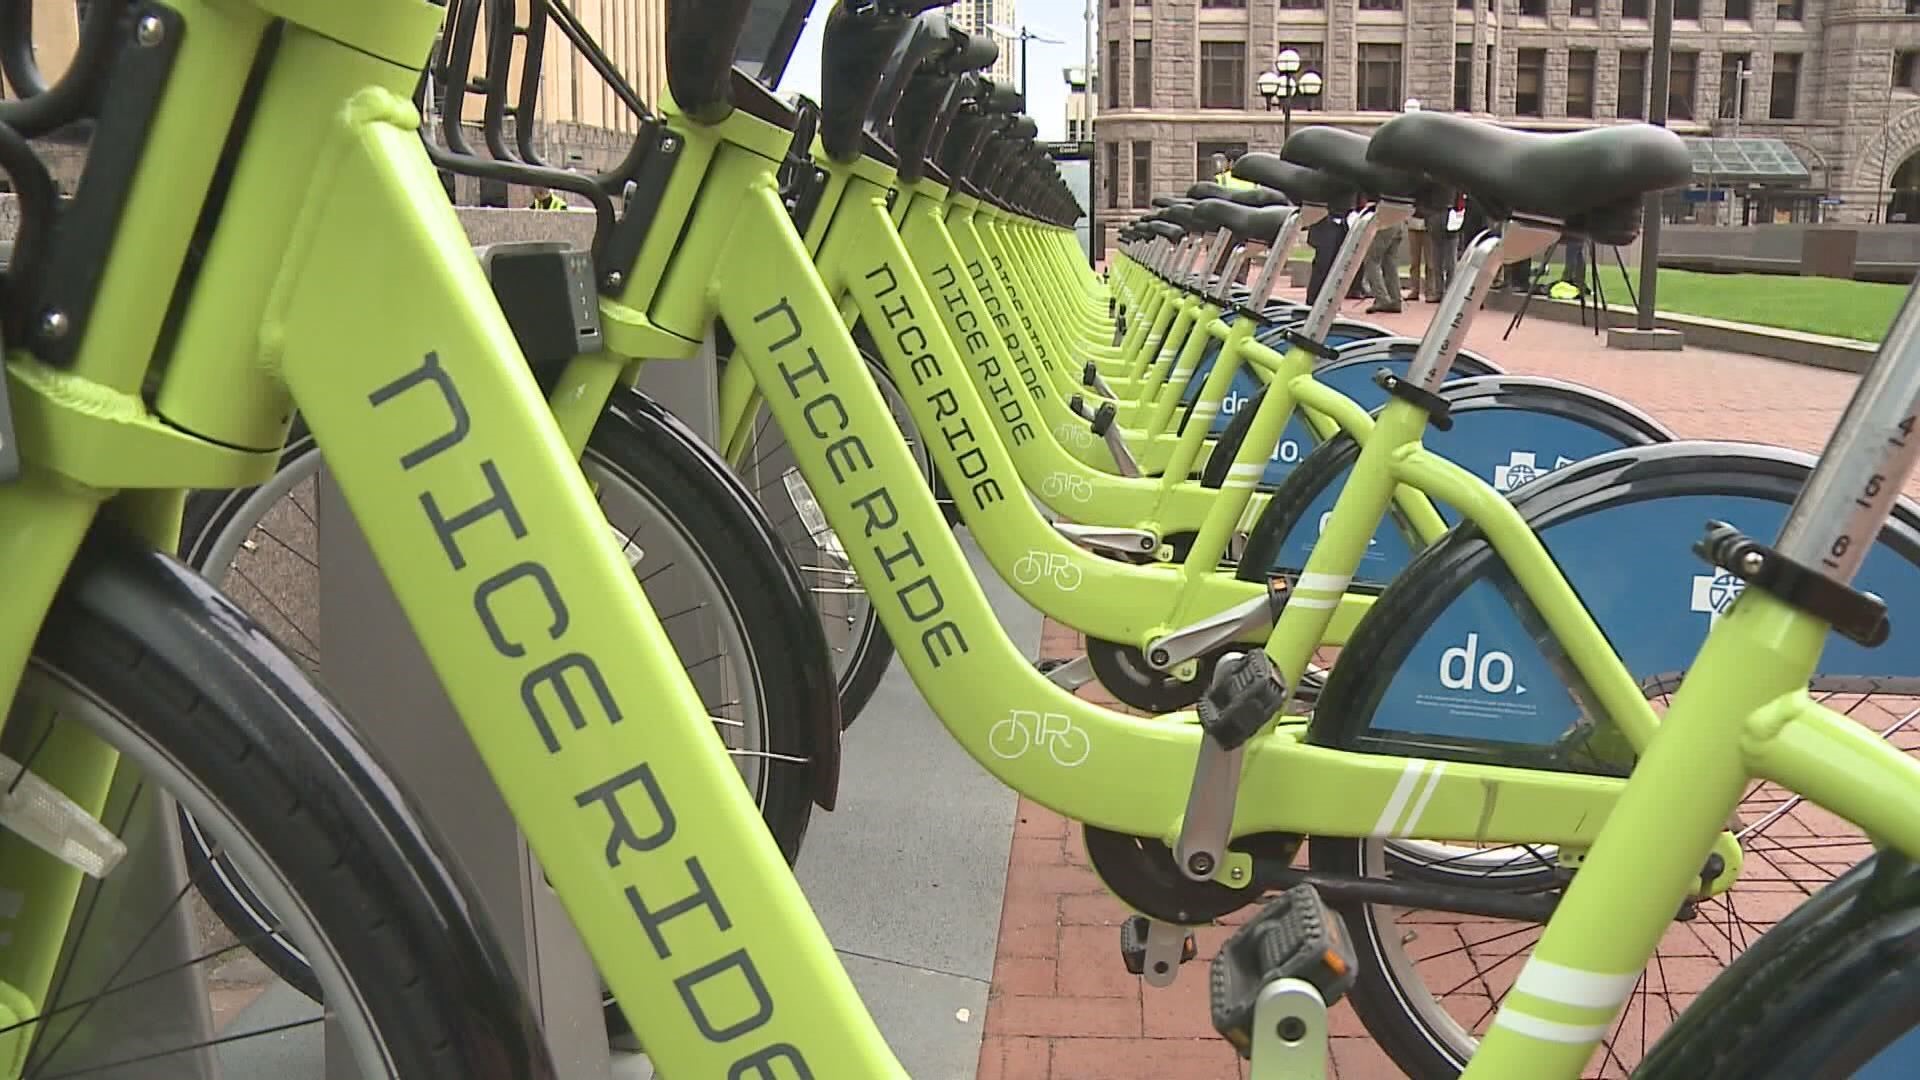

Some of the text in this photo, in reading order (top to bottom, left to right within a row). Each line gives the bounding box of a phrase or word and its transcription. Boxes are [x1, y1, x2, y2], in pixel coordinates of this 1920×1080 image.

[754, 296, 969, 668] NICE RIDE
[865, 262, 1005, 511] NICE RIDE
[932, 263, 1035, 447] NICE RIDE
[368, 351, 624, 755] NICE
